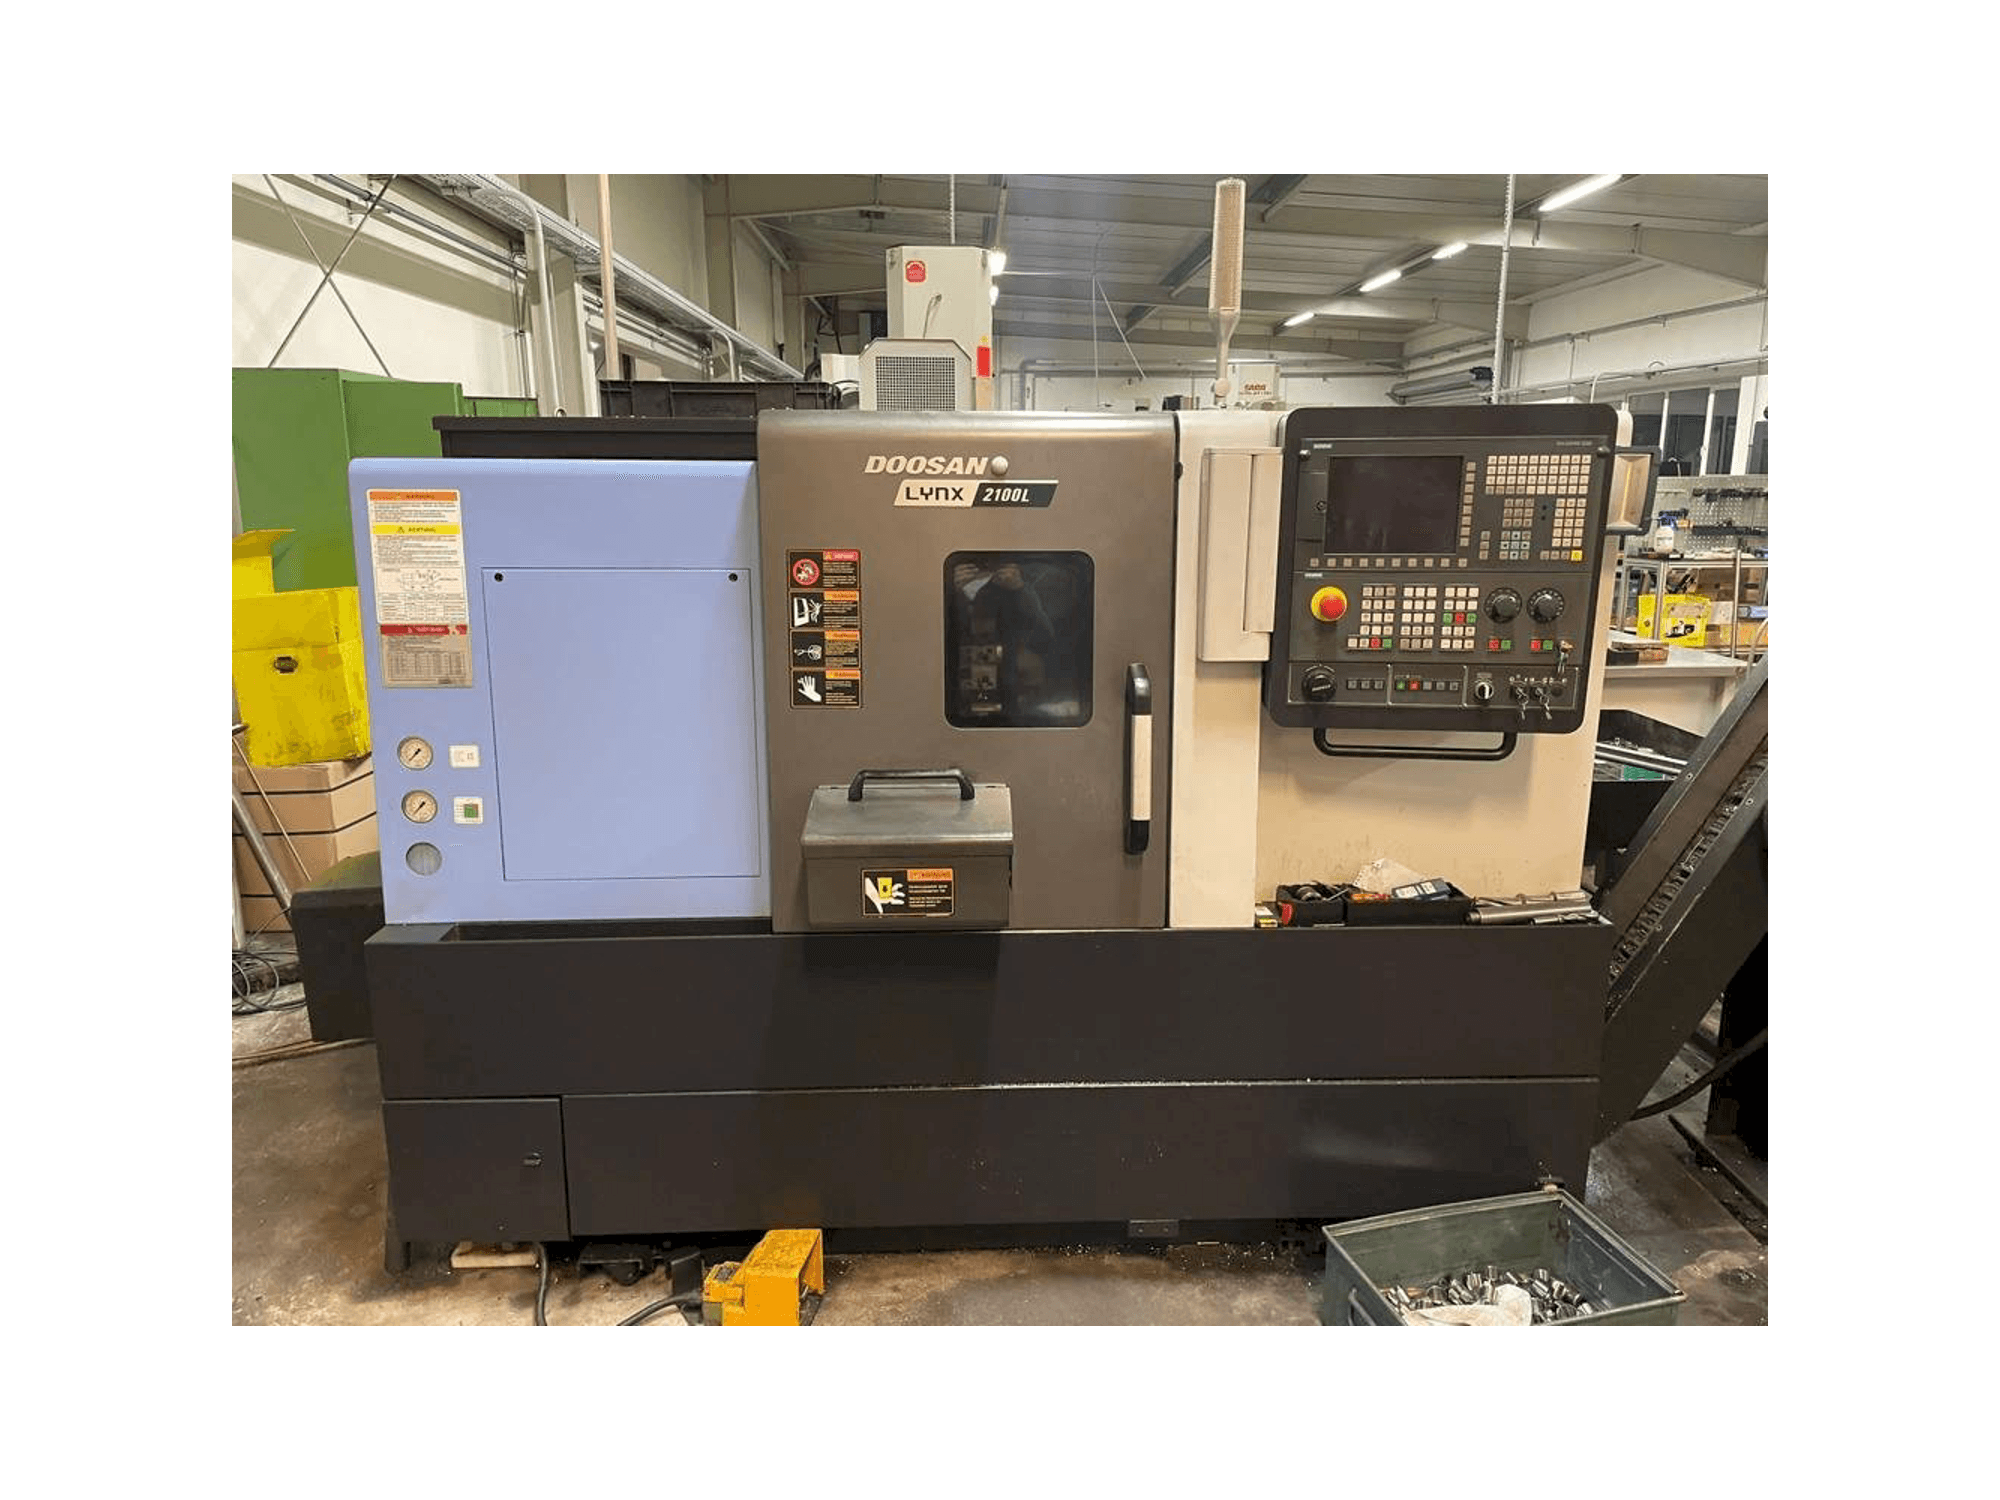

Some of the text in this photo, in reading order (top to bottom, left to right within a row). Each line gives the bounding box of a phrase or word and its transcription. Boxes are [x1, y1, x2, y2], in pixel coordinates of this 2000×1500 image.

[864, 455, 989, 475] DOOSAN
[905, 486, 1030, 502] LYNX 2100L
